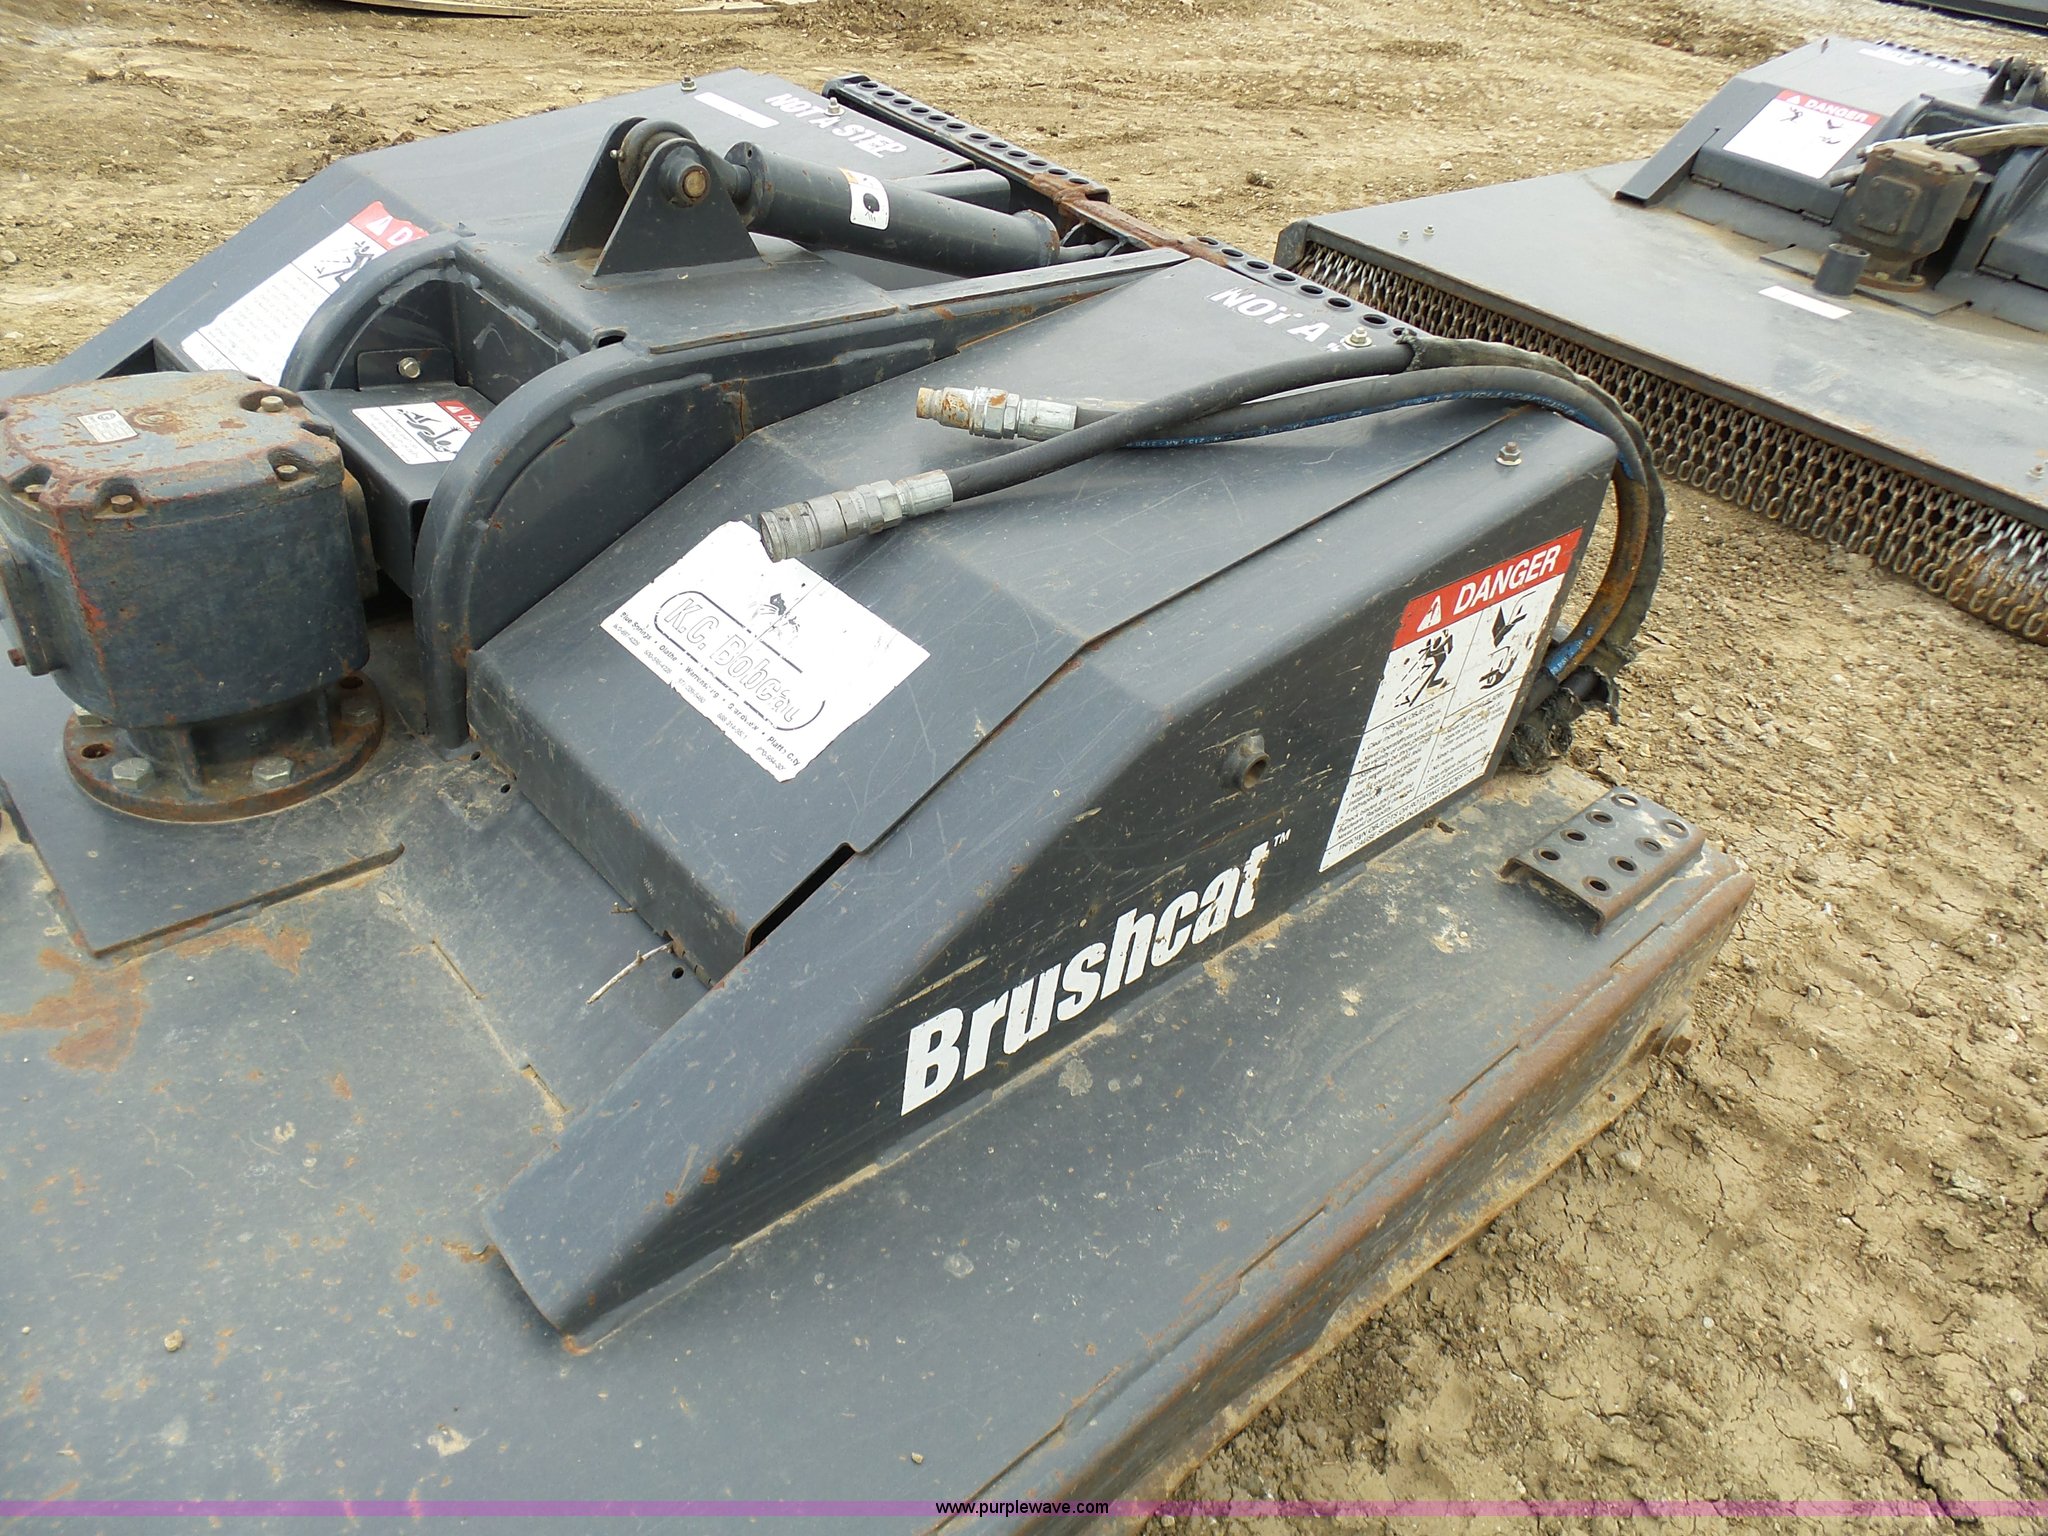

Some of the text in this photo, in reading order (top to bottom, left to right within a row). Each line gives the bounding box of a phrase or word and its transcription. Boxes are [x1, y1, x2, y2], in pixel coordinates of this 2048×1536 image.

[765, 93, 908, 159] NOT A STEP
[1803, 98, 1870, 123] DANGER
[1286, 321, 1331, 343] A
[1453, 544, 1562, 616] DANGER
[658, 644, 679, 662] Olathe
[664, 597, 721, 653] K.C.
[901, 828, 1292, 1117] Brushcat TM
